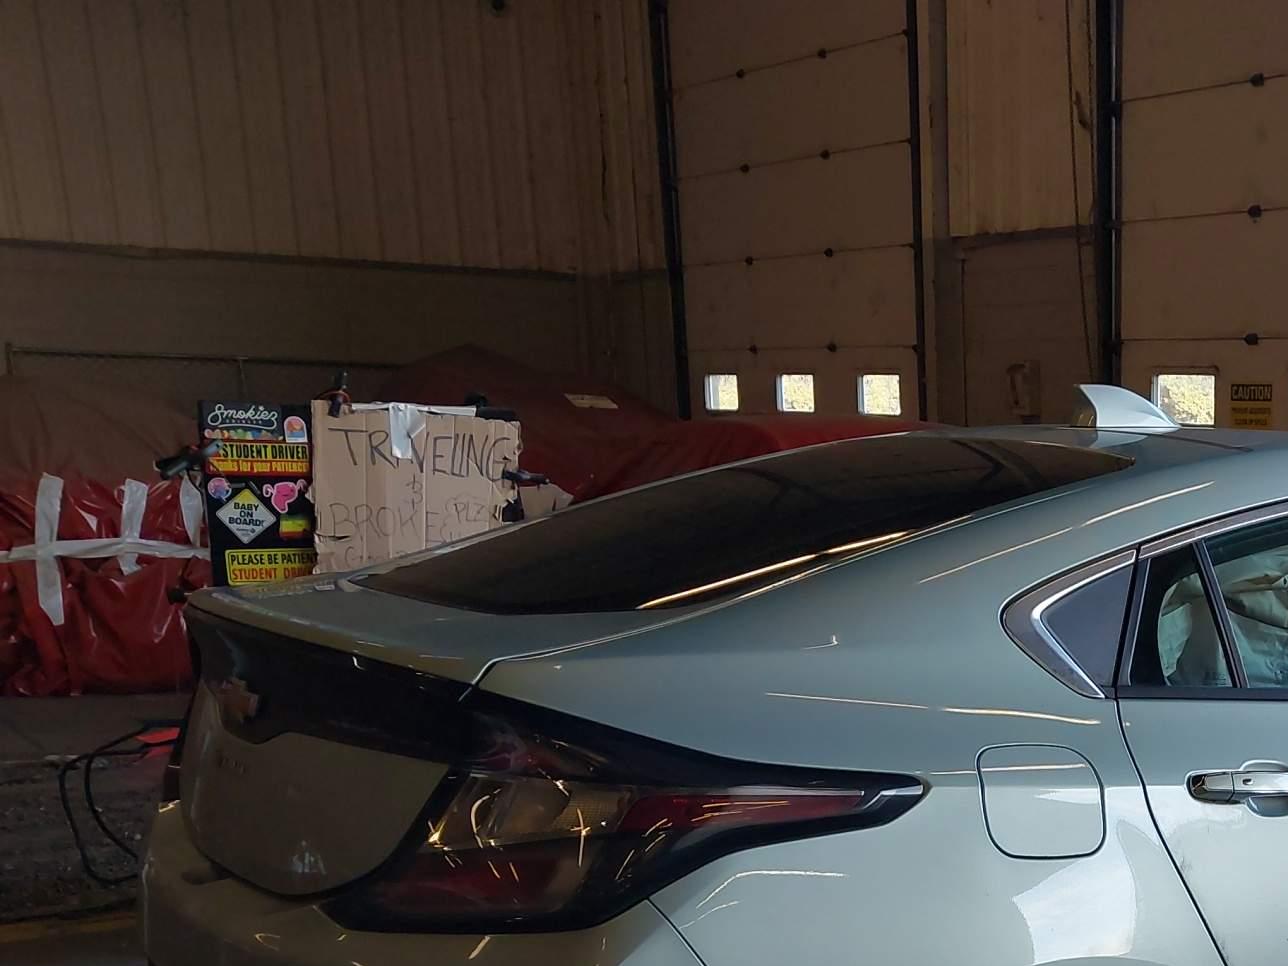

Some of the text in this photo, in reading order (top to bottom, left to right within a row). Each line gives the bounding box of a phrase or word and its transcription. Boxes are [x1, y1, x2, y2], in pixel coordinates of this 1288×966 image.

[1231, 386, 1272, 400] CAUTION
[207, 403, 278, 430] Smokiez
[222, 443, 308, 460] STUDENT DRIVER
[328, 428, 511, 483] TRVELING
[233, 502, 260, 512] BABY
[453, 500, 488, 525] PLZ
[239, 510, 254, 519] ON
[228, 516, 265, 528] BOARD!
[329, 502, 442, 544] BROKE
[230, 553, 265, 566] PLEASE
[267, 553, 279, 565] BE
[232, 567, 277, 581] STUDENT
